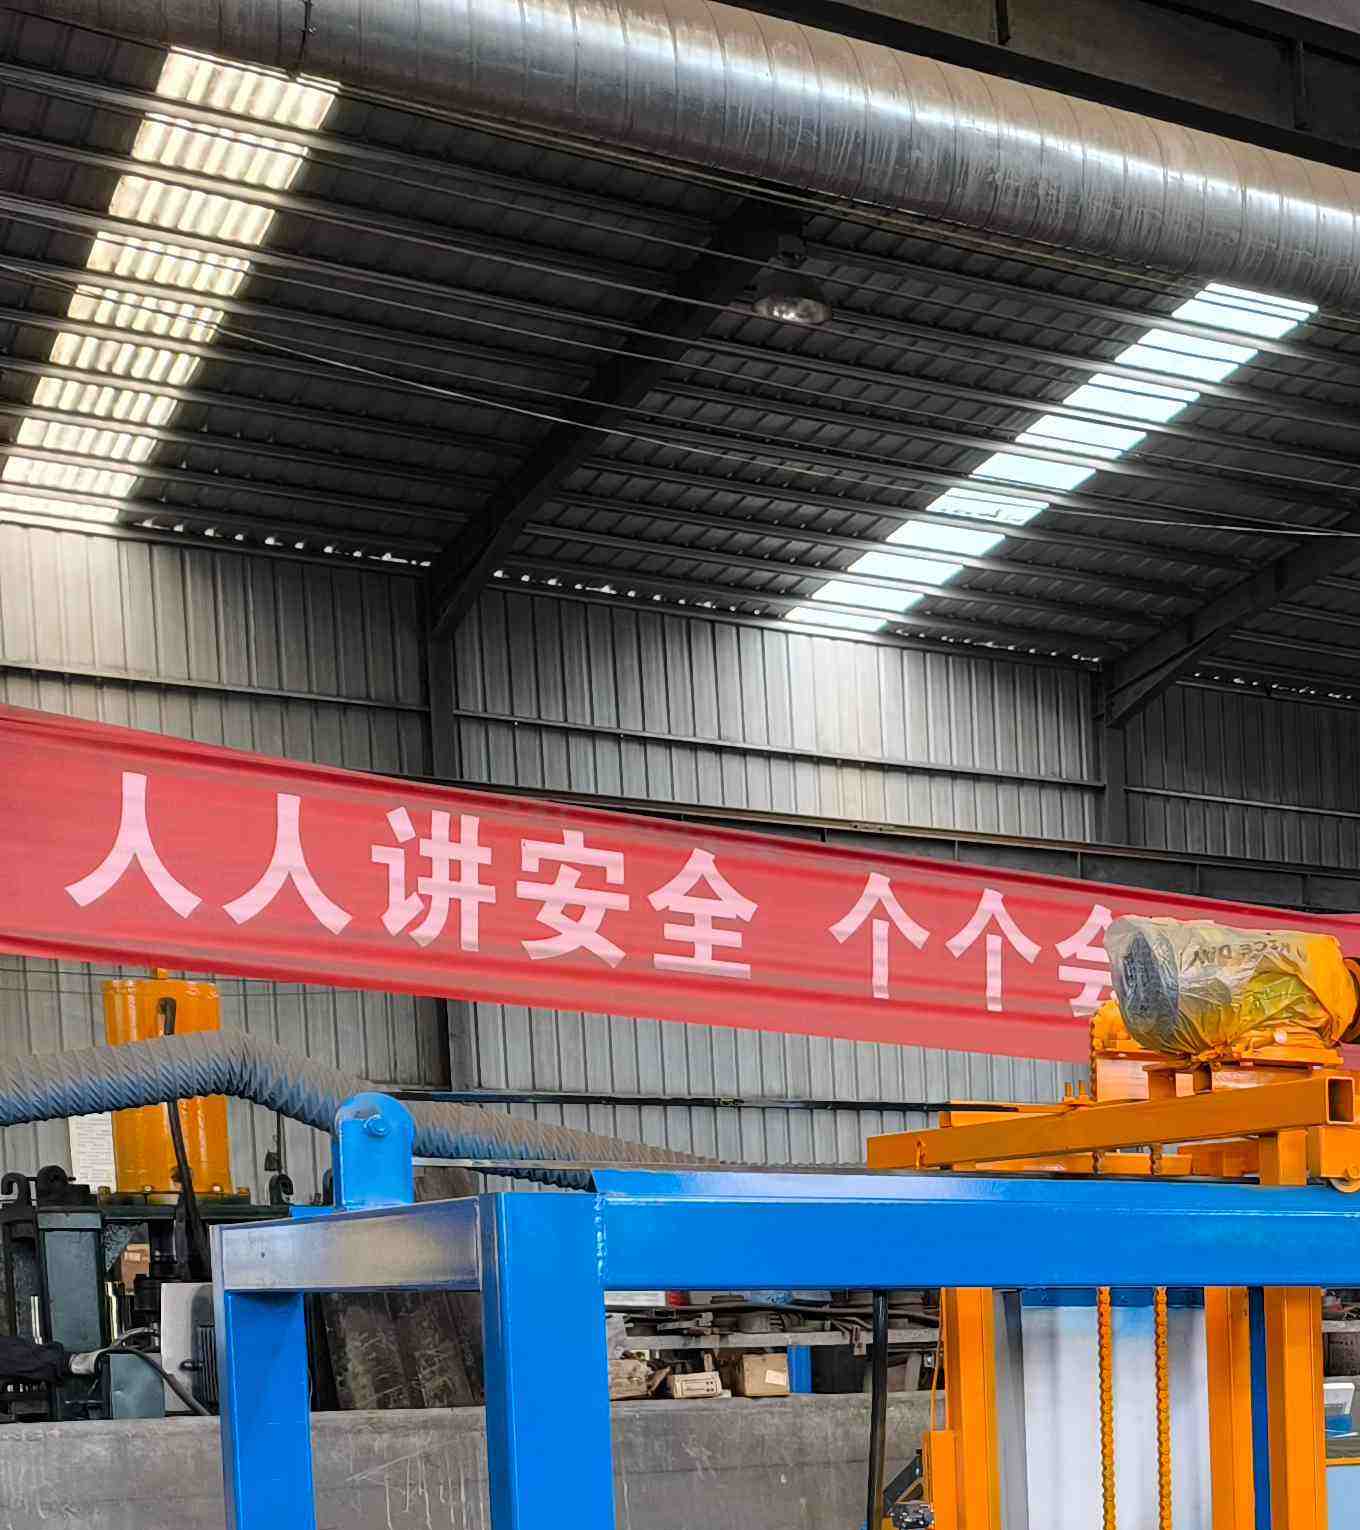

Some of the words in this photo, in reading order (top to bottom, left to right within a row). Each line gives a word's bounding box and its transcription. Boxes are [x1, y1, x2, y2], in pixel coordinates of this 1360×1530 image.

[64, 771, 759, 980] 人人讲安全
